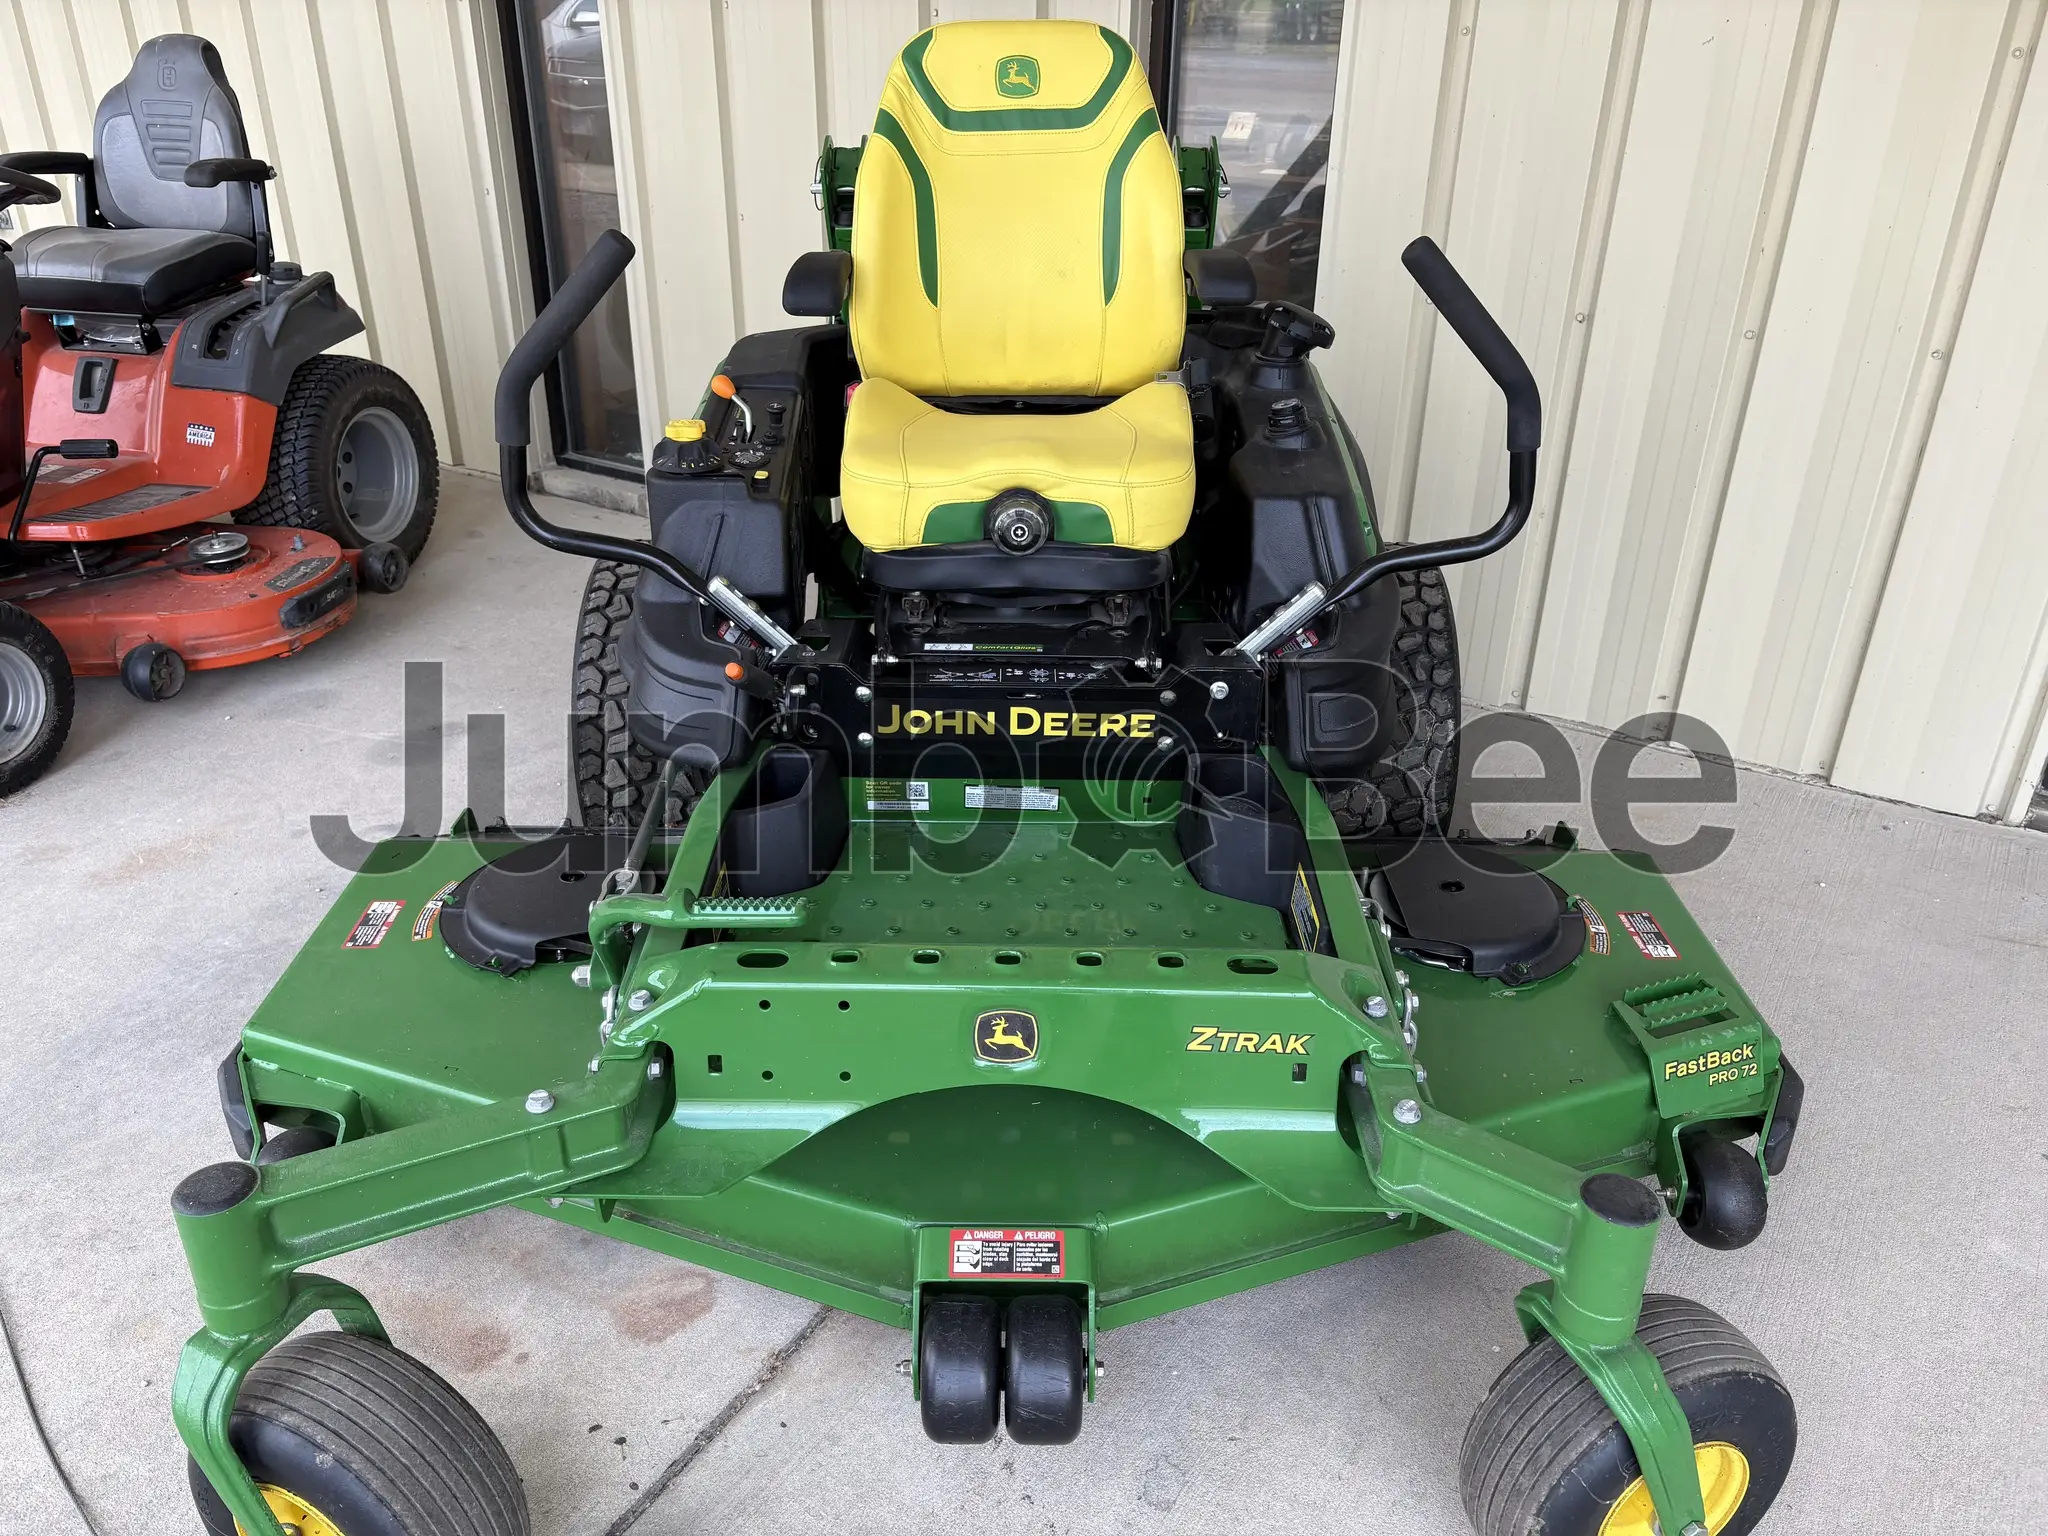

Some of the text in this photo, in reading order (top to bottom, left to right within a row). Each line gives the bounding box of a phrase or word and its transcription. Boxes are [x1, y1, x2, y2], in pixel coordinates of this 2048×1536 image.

[877, 704, 1156, 738] JOHN DEERE
[1185, 1026, 1315, 1055] ZTRAK
[1664, 1042, 1755, 1081] FastBack
[1709, 1063, 1758, 1086] PRO 72
[974, 1231, 1004, 1239] DANGER
[1025, 1231, 1056, 1240] PELIGRO
